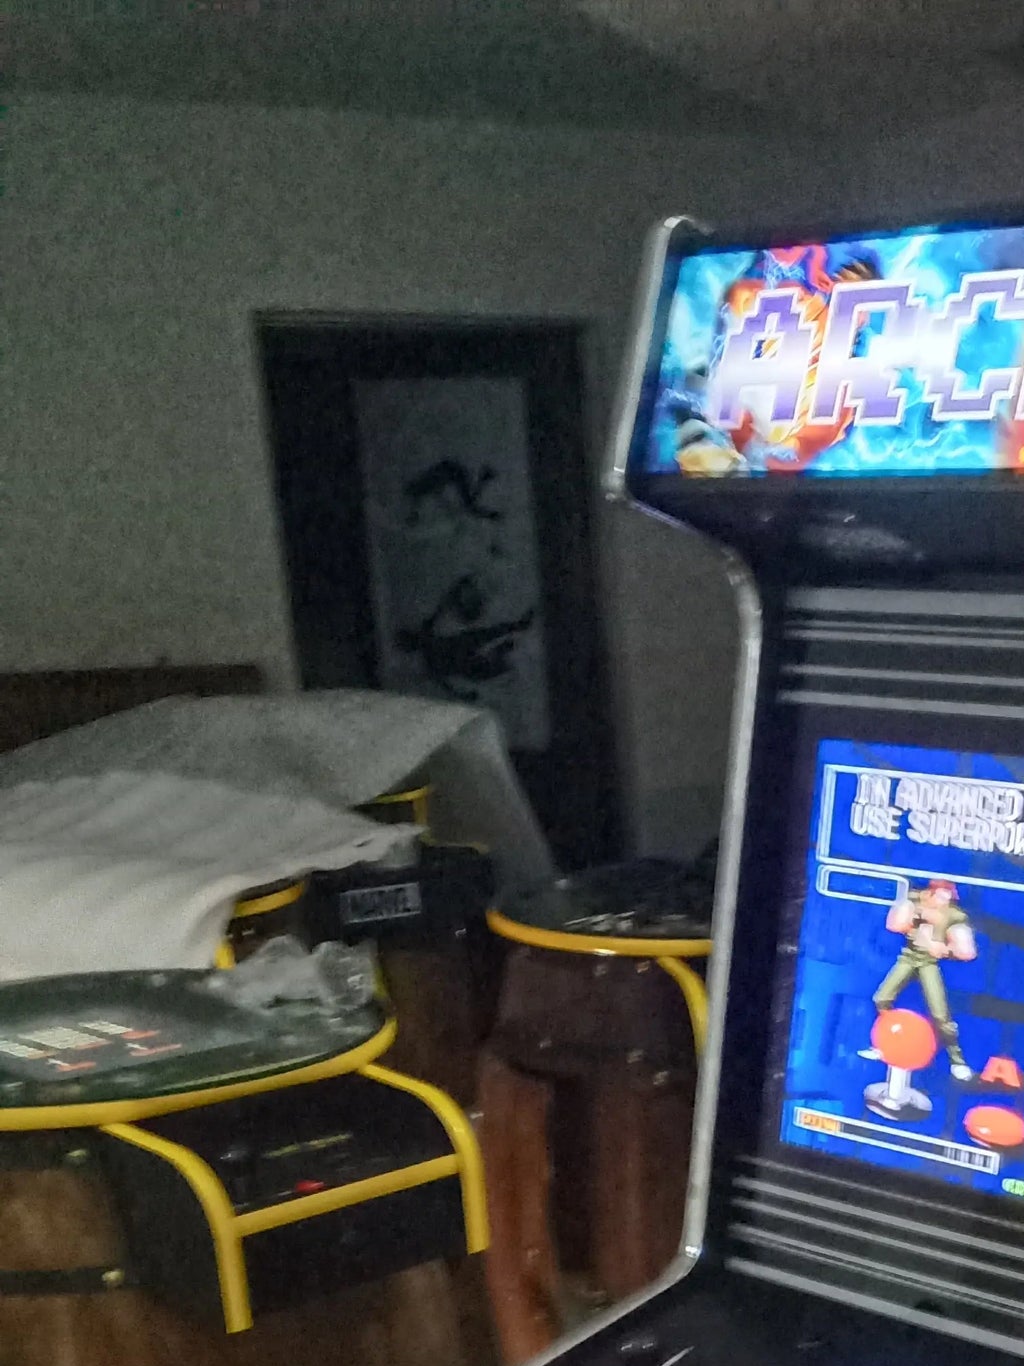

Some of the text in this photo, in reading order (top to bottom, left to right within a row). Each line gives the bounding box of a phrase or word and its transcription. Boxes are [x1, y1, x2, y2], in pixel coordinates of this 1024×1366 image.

[854, 773, 891, 805] IN
[895, 777, 1024, 822] ADVANCED
[850, 803, 901, 841] USE
[980, 1056, 1021, 1088] A
